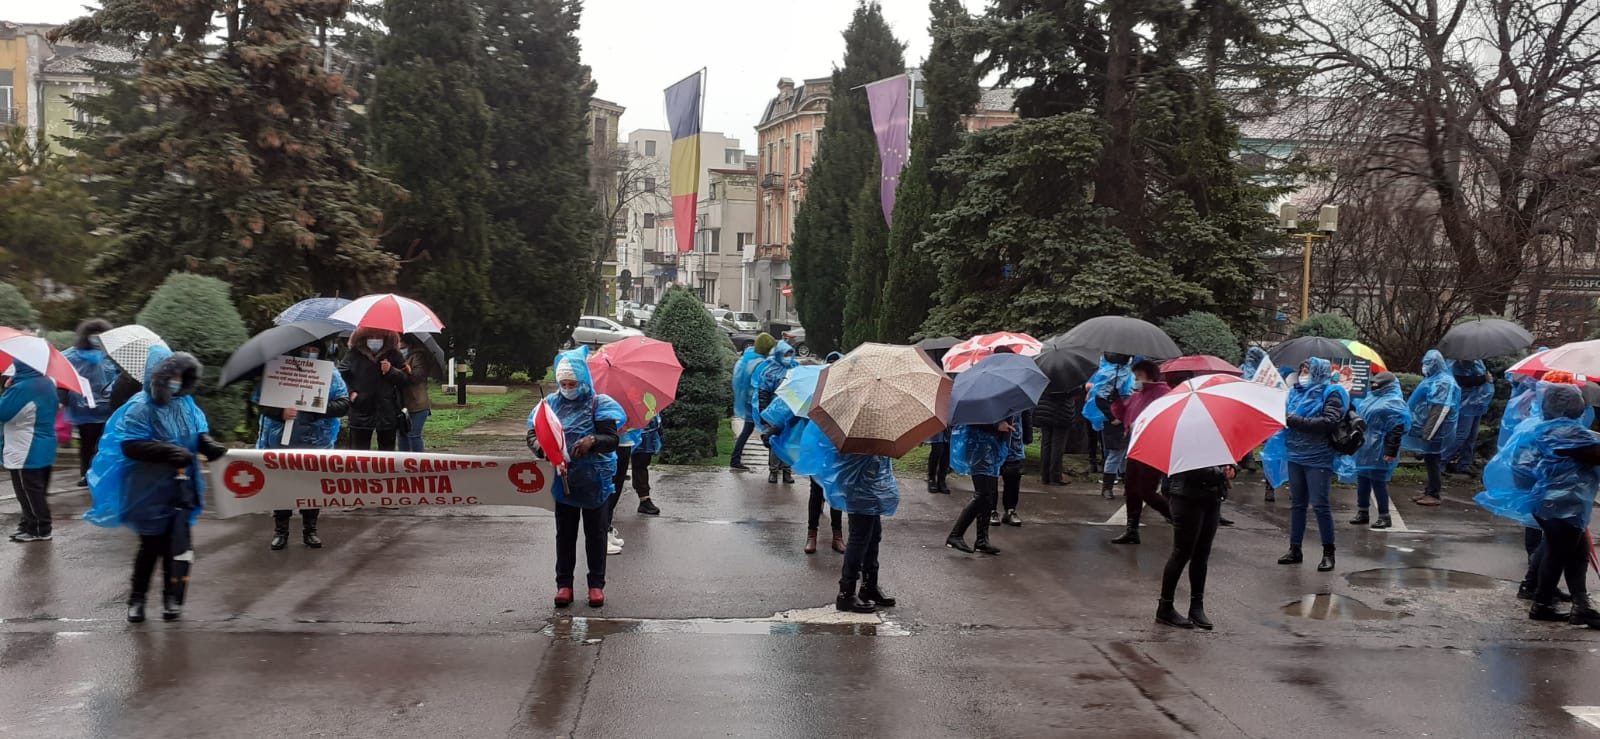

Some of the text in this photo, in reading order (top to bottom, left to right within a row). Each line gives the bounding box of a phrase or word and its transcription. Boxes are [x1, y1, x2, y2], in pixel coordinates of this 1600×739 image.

[263, 452, 399, 473] SINDICATUL
[320, 475, 453, 495] CONSTANTA
[296, 497, 364, 508] FILIALA
[380, 496, 483, 506] D.G.A.S.P.C.
